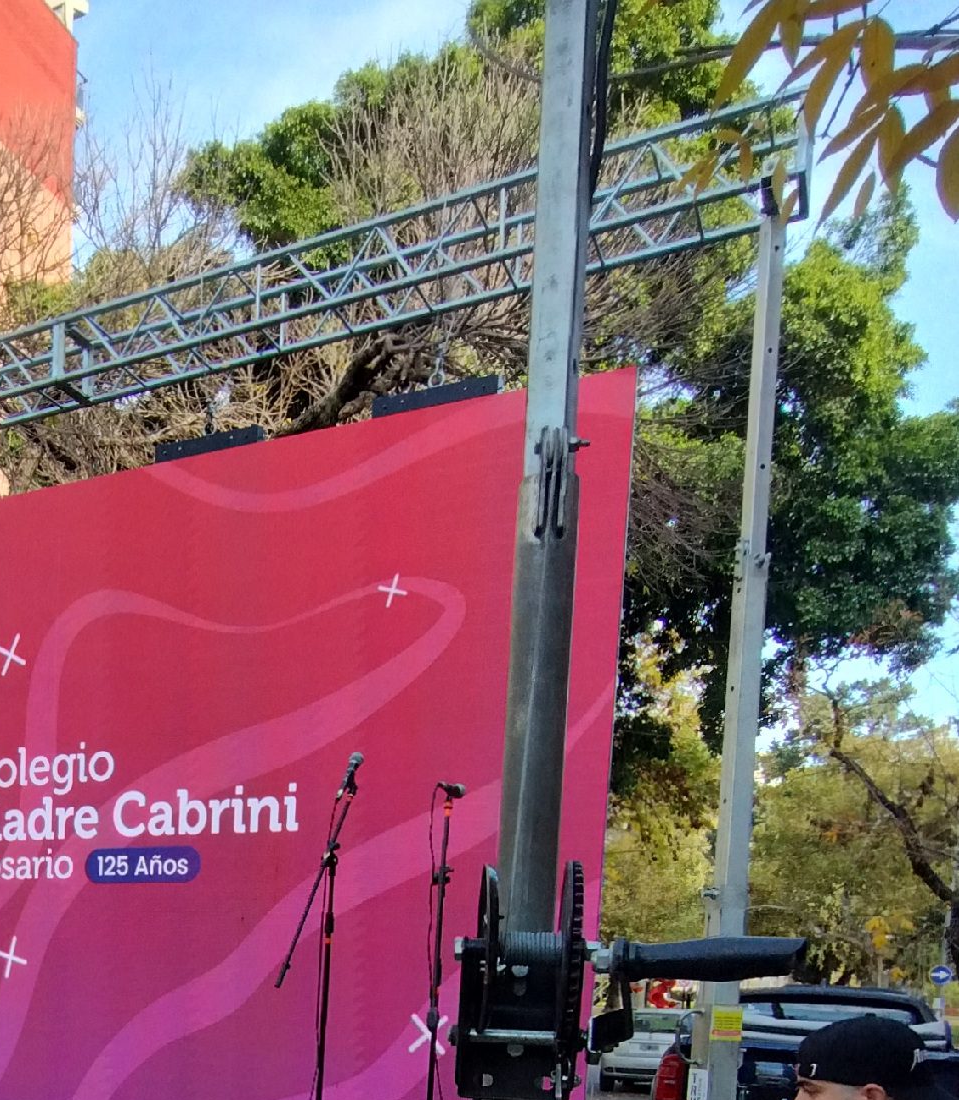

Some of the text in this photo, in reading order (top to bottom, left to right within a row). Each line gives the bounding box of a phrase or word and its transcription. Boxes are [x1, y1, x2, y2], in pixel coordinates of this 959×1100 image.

[113, 783, 298, 837] Cabrini
[98, 856, 188, 875] 125 Años
